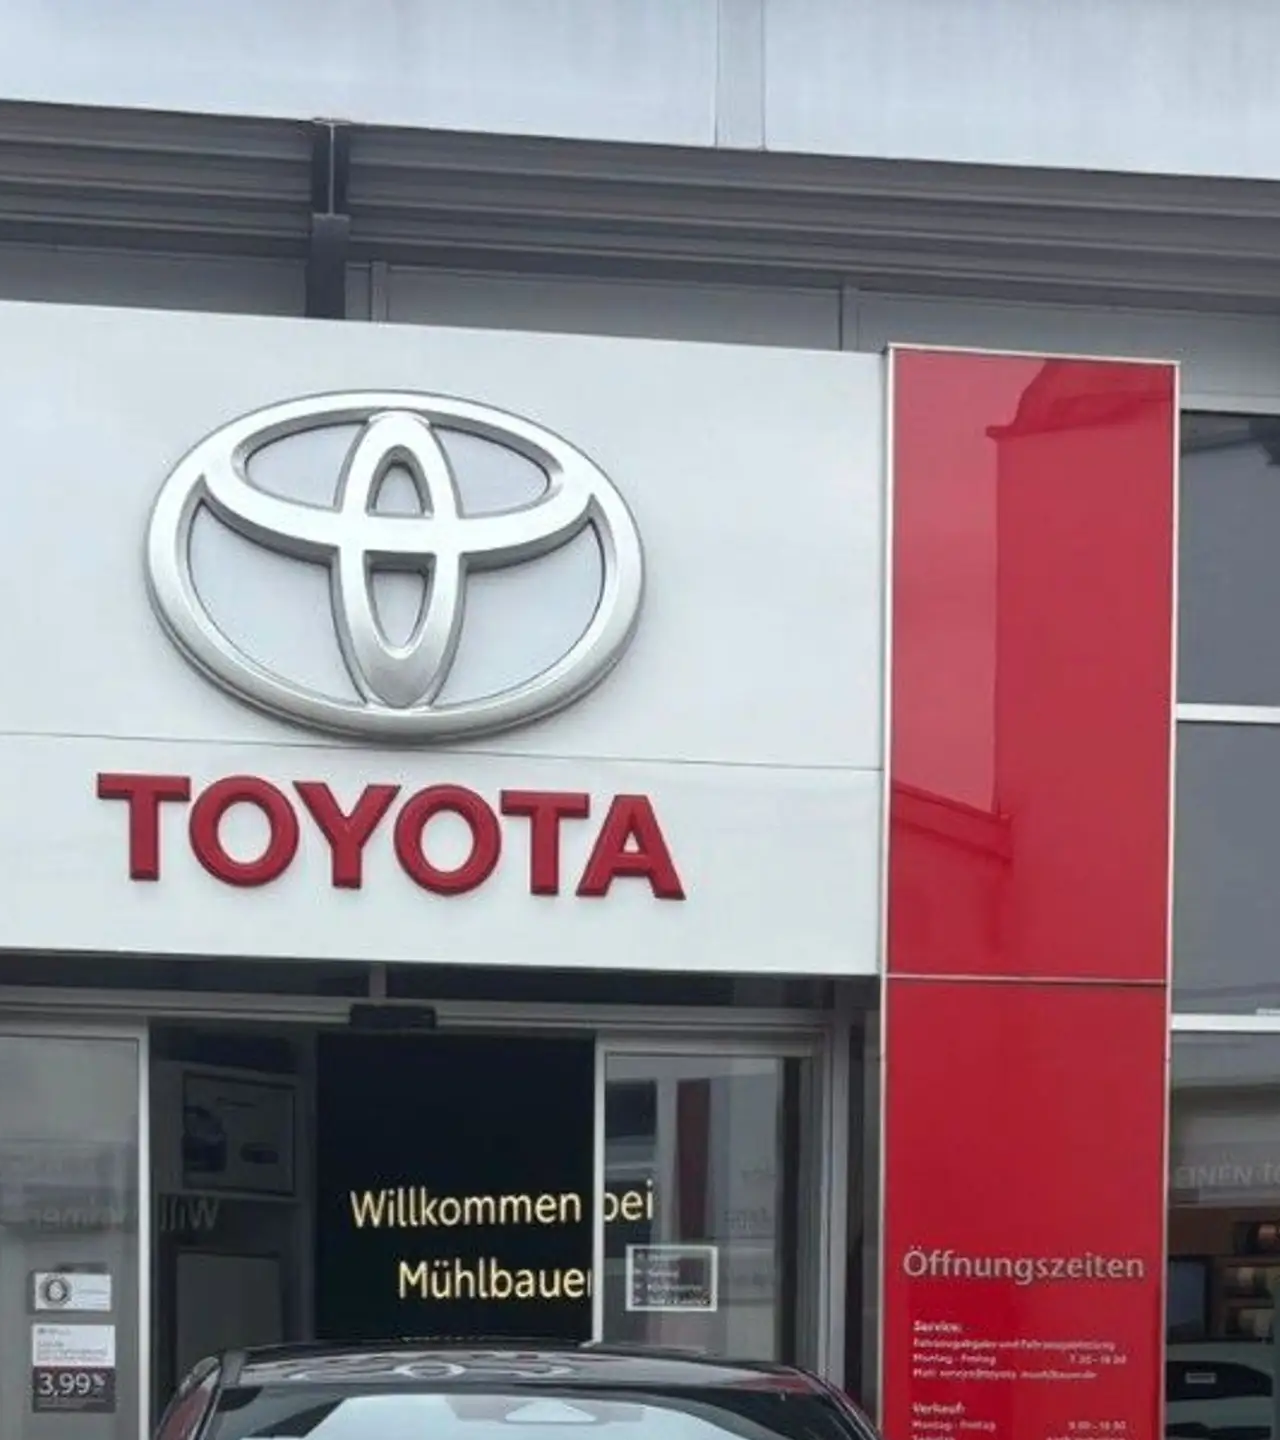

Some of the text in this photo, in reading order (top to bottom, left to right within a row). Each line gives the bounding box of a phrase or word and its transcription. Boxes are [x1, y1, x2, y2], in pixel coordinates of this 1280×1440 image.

[96, 772, 687, 901] TOYOTA
[349, 1185, 583, 1229] Willkommen
[903, 1245, 1145, 1286] Öffnungszeiten
